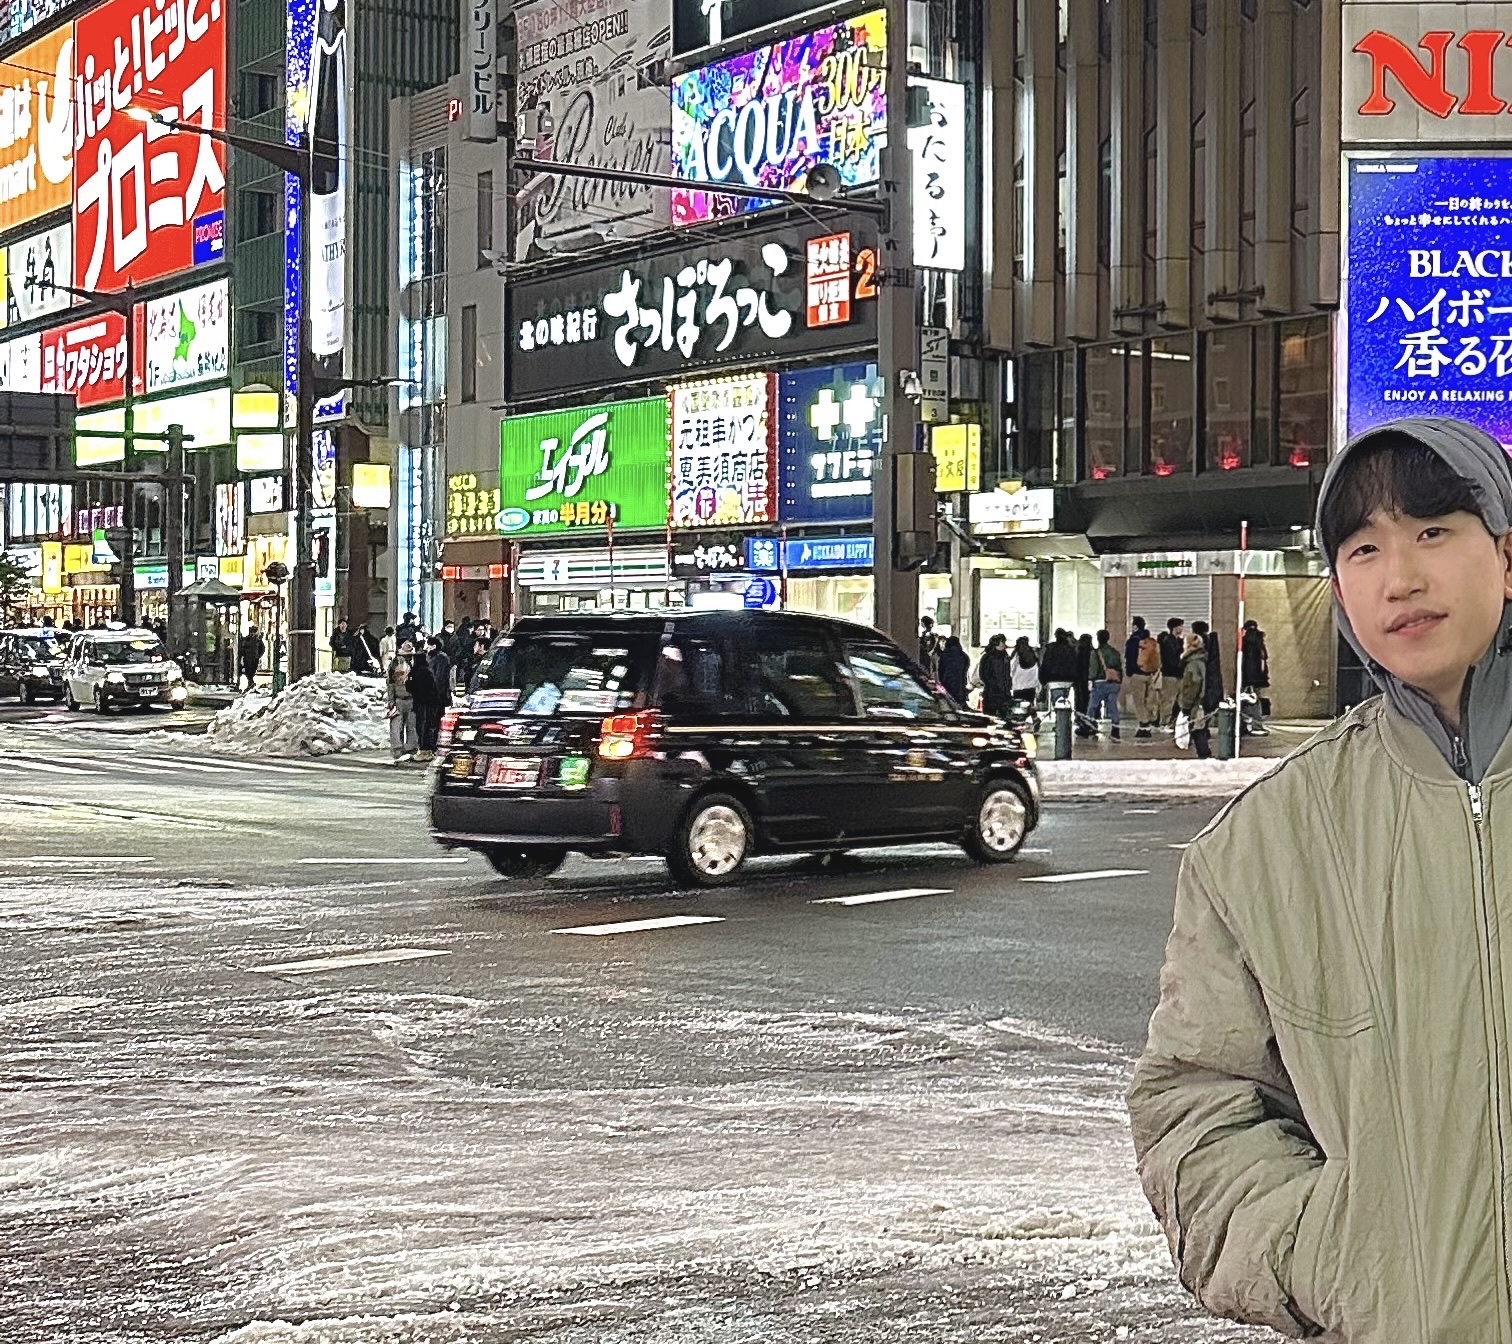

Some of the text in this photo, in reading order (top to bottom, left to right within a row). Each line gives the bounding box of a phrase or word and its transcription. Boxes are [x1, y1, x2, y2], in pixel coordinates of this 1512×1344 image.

[77, 67, 226, 298] プロミス
[602, 242, 792, 367] さっぽろっこ
[931, 407, 938, 418] 3
[1383, 389, 1426, 402] ENJOY
[1428, 389, 1438, 402] A
[1441, 389, 1505, 402] RELAXING
